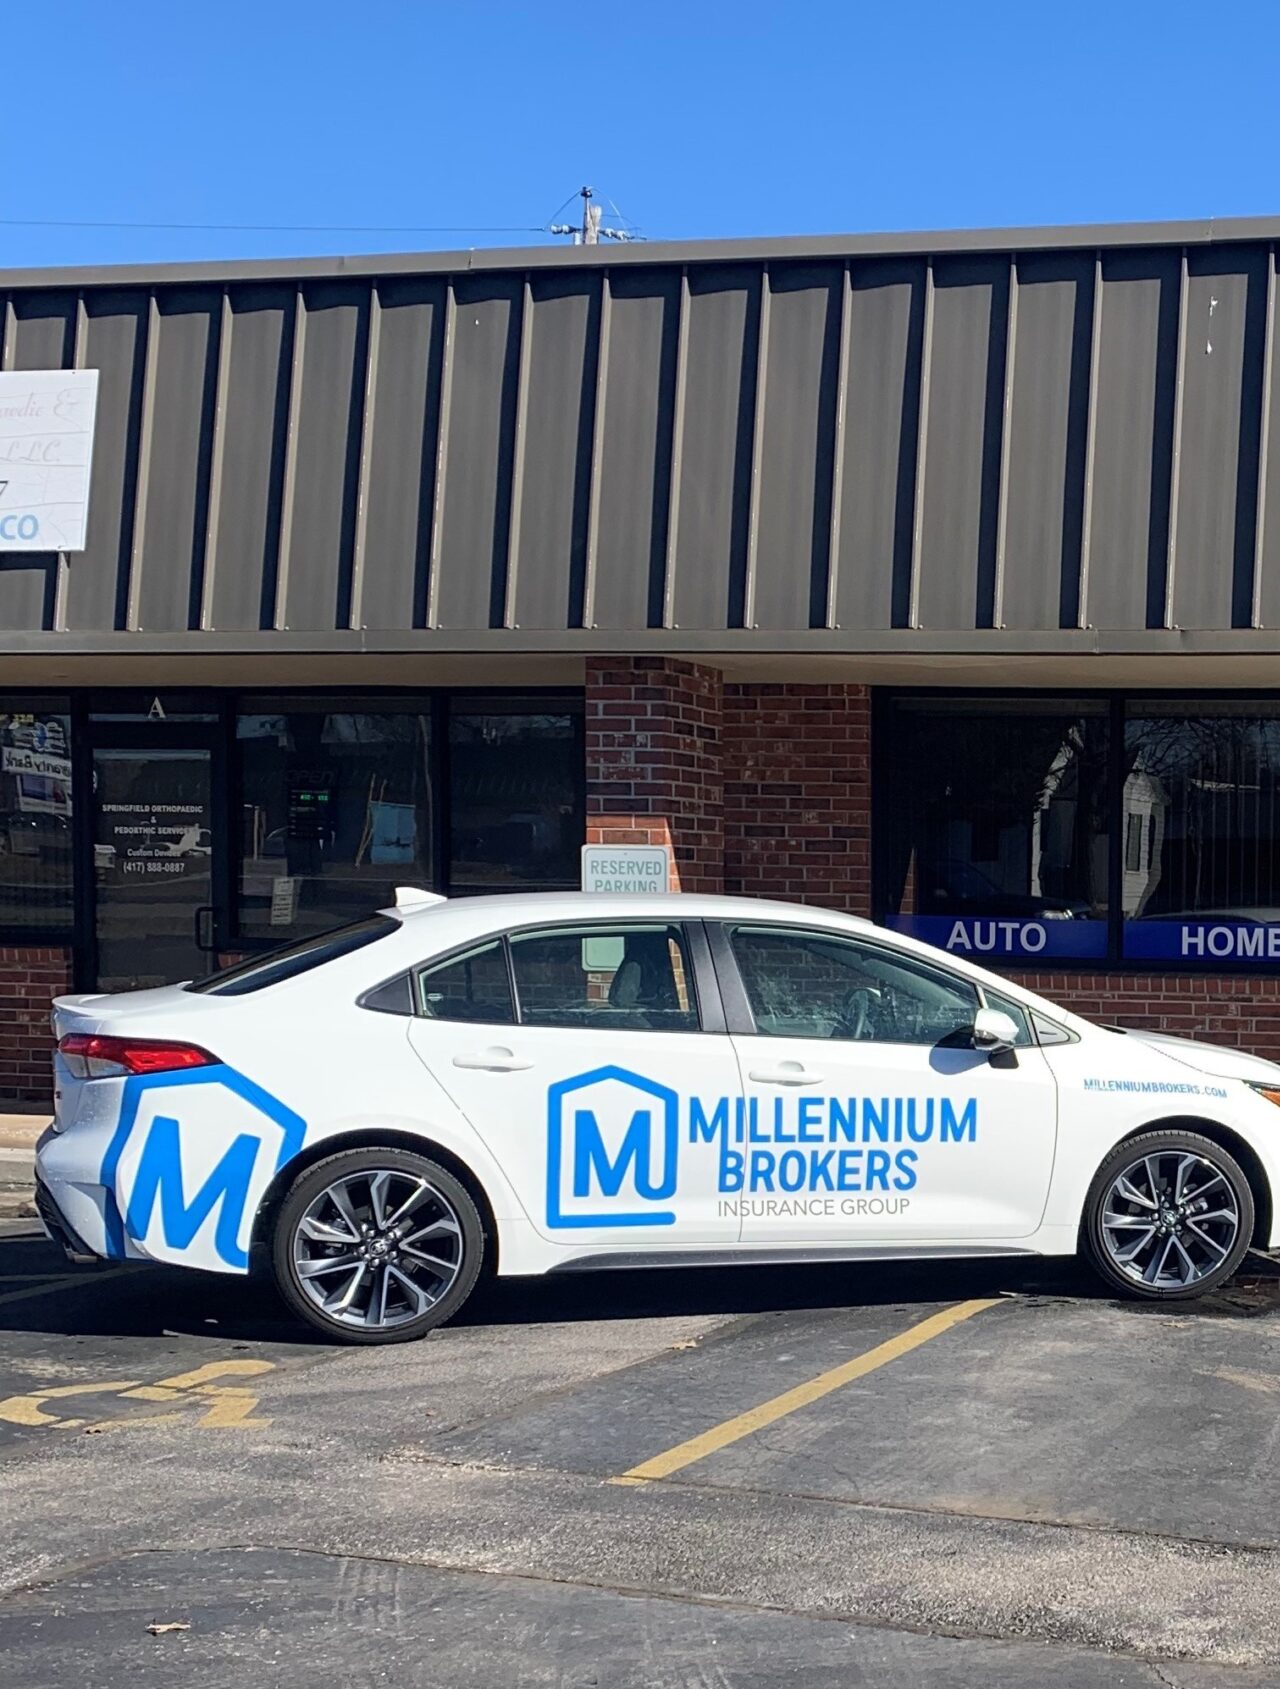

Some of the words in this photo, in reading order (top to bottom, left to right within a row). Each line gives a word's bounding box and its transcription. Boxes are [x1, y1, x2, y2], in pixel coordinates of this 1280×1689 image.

[148, 696, 166, 719] A
[102, 804, 150, 813] SPRINGFIELD
[151, 804, 204, 814] ORTHOPAEDIC
[114, 826, 156, 835] PEDORTHIC
[157, 826, 194, 835] SERVICE
[127, 848, 153, 857] Custom
[123, 862, 145, 874] (417)
[590, 860, 662, 875] RESERVED
[594, 880, 657, 893] PARKING
[946, 921, 1048, 953] AUTO
[1083, 1078, 1228, 1098] MILLENNIUMBROKERS.COM
[689, 1096, 978, 1143] MILLENNIUM
[718, 1148, 919, 1192] BROKERS
[718, 1199, 835, 1218] INSURANCE
[840, 1198, 911, 1217] GROUP
